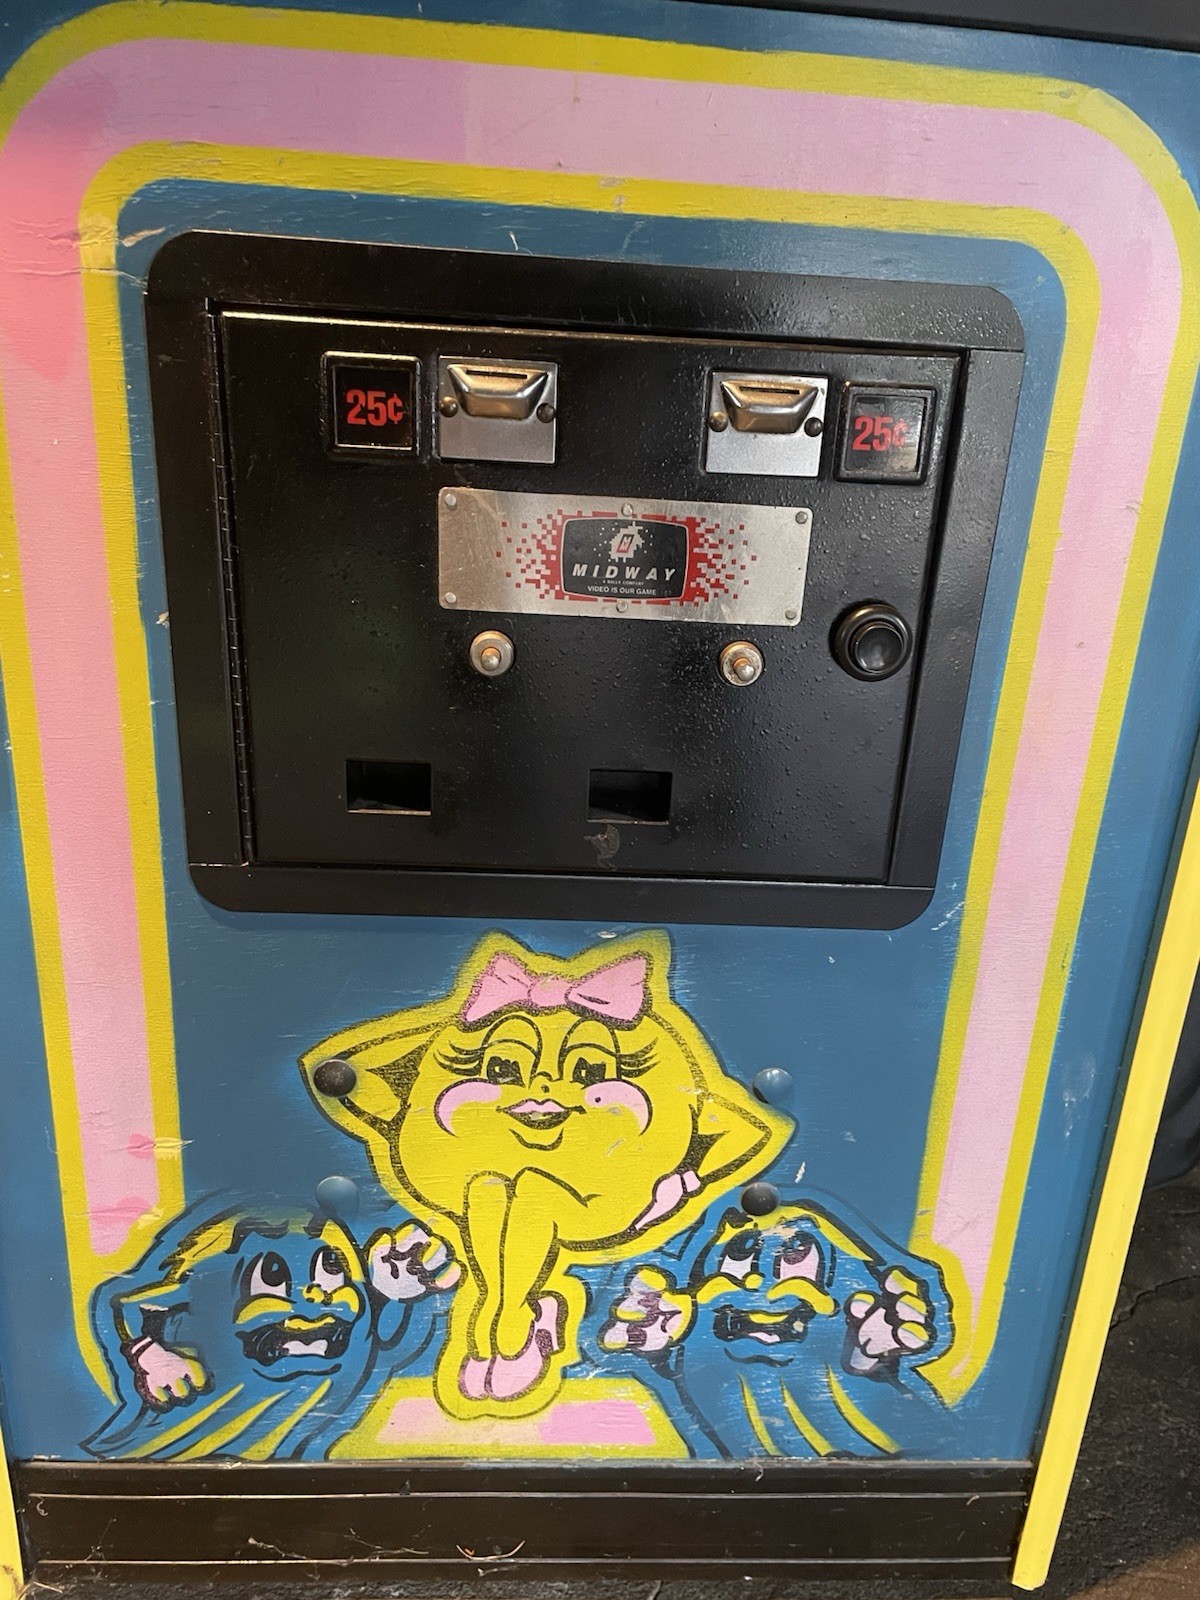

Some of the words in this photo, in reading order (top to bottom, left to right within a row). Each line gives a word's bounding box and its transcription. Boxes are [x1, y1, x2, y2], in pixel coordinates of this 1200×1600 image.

[346, 389, 404, 427] 25¢
[852, 415, 910, 452] 25¢
[572, 564, 676, 581] MIDWAY
[587, 585, 610, 593] VIDEO
